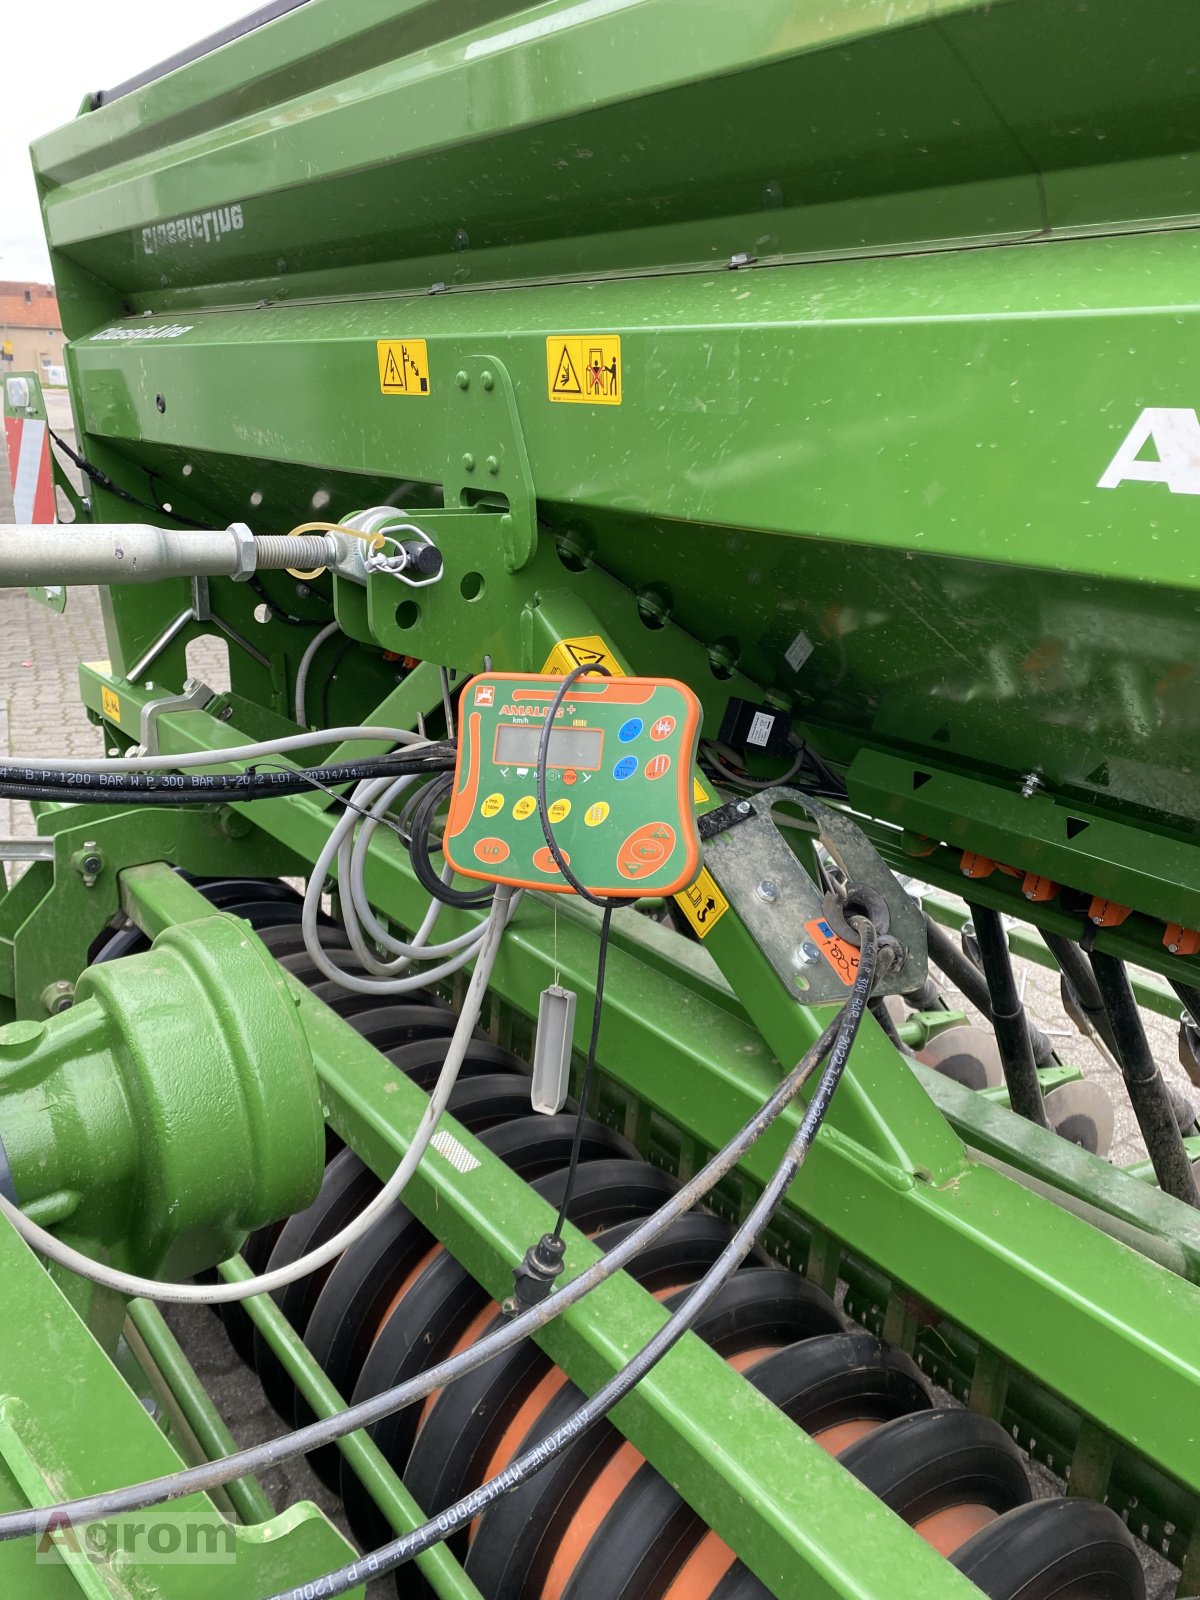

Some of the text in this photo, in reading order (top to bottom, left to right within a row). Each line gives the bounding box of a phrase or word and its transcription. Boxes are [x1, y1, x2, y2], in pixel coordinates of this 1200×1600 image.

[99, 774, 124, 787] BAR
[191, 776, 214, 787] BAR
[527, 1407, 591, 1466] AMAZONE
